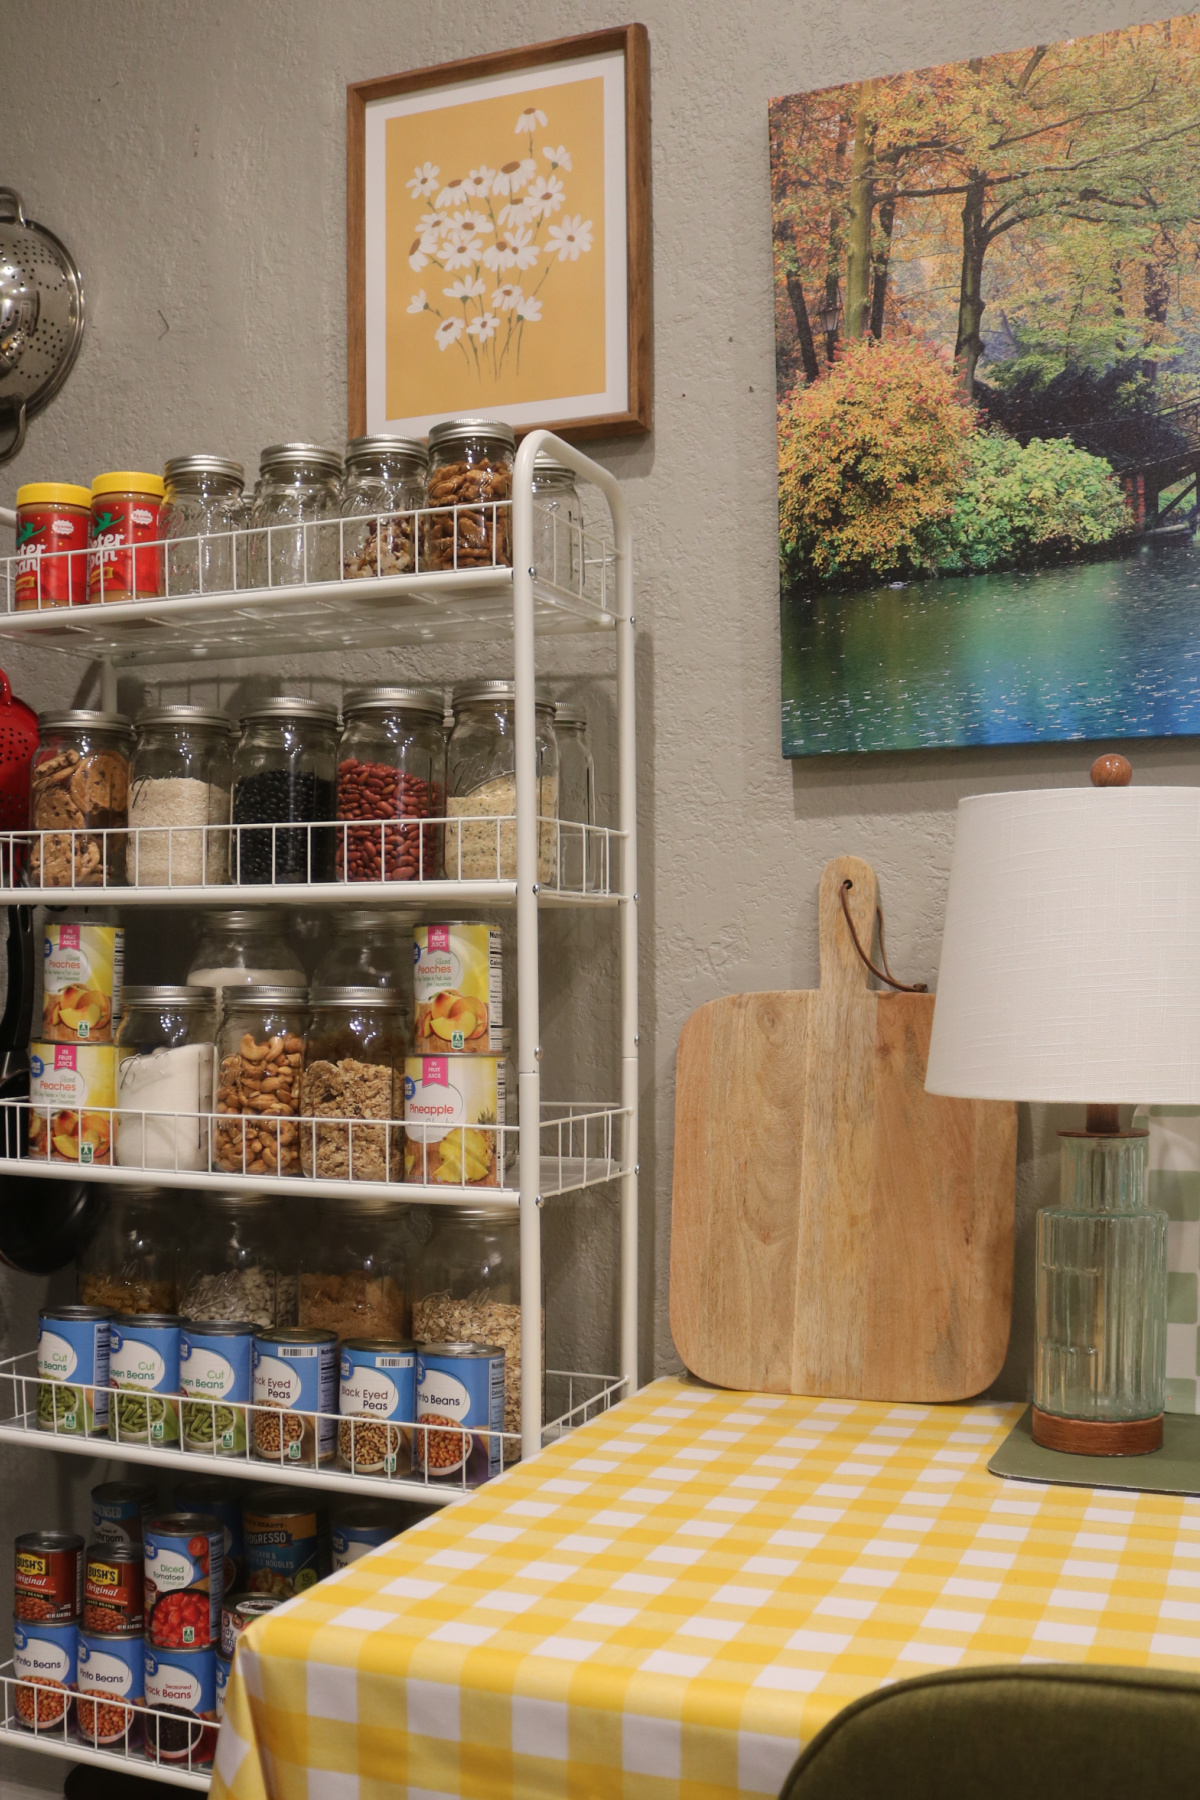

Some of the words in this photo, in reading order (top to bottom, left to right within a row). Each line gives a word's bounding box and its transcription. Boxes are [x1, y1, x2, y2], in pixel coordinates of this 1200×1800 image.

[90, 534, 125, 549] eter
[49, 960, 80, 969] Peaches
[418, 965, 451, 974] Peaches
[40, 1080, 76, 1091] Peaches
[410, 1103, 454, 1116] Pineapple
[52, 1353, 67, 1362] Cut
[43, 1361, 67, 1371] Beans
[138, 1361, 155, 1370] Cut
[126, 1370, 155, 1380] Beans
[207, 1370, 224, 1379] Cut
[196, 1379, 224, 1389] Beans
[268, 1378, 291, 1389] Eyed
[268, 1389, 291, 1399] Peas
[363, 1390, 388, 1400] Eyed
[430, 1394, 460, 1406] Beans
[363, 1400, 388, 1411] Peas
[17, 1557, 43, 1572] BUSH'S
[161, 1564, 184, 1573] Diced
[265, 1560, 294, 1569] NOODLES
[88, 1566, 115, 1582] BUSH'S
[153, 1571, 184, 1581] Tomatoes
[302, 1573, 310, 1582] 15
[16, 1574, 46, 1586] Original
[87, 1583, 118, 1597] Original
[16, 1654, 31, 1667] Pinto
[33, 1660, 61, 1669] Beans
[80, 1668, 93, 1680] Pinto
[96, 1673, 124, 1683] Beans
[162, 1690, 192, 1699] Beans
